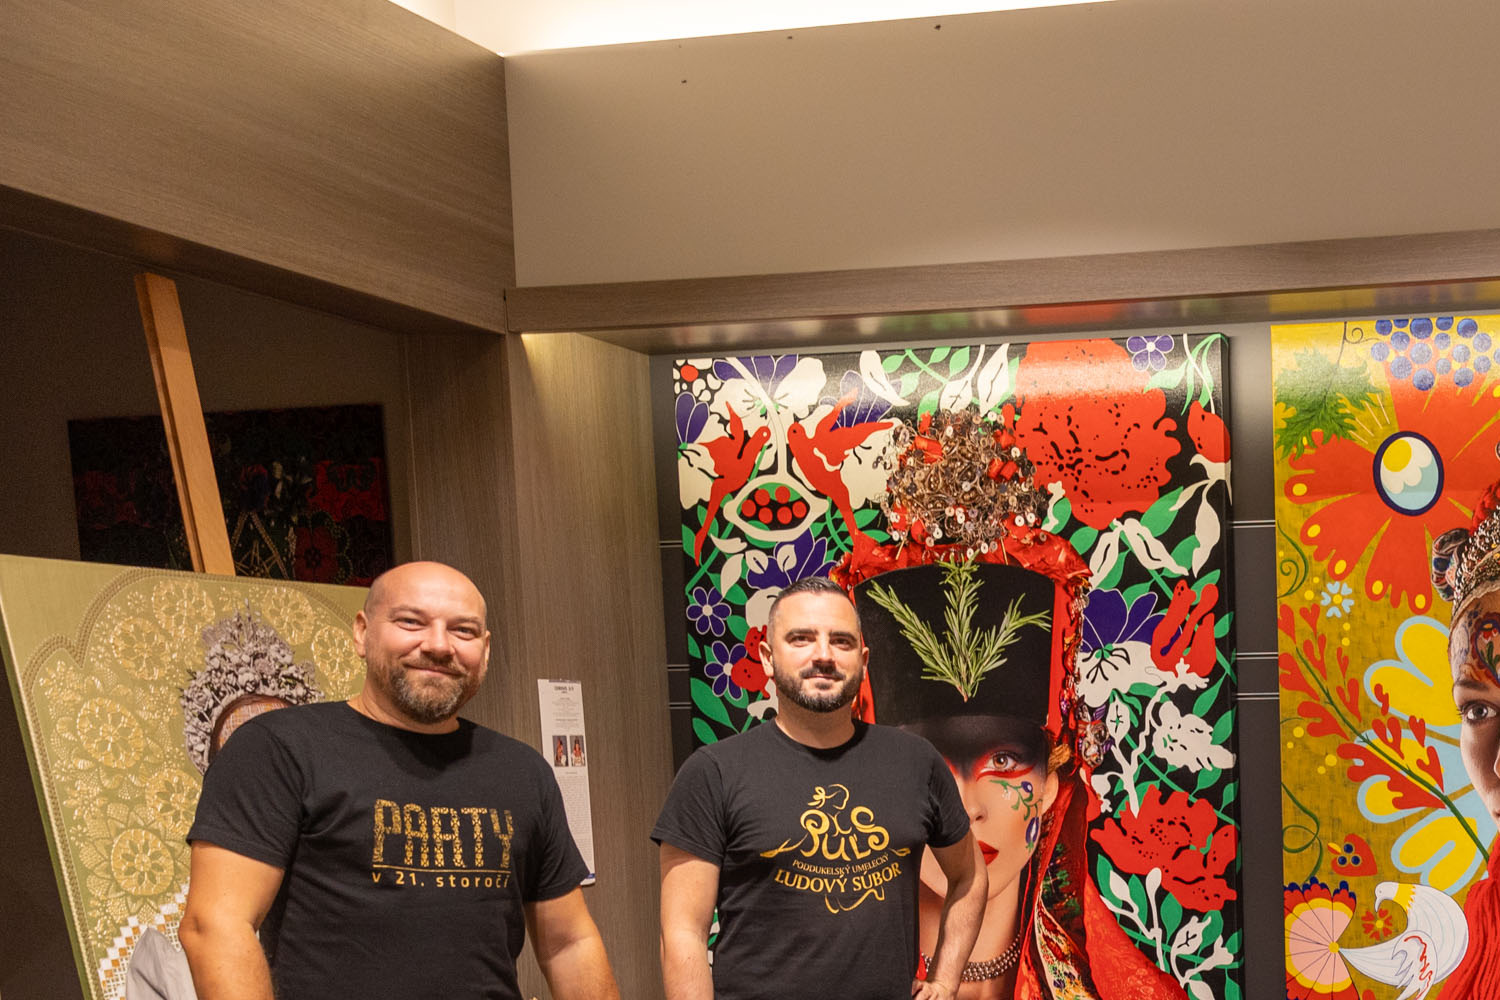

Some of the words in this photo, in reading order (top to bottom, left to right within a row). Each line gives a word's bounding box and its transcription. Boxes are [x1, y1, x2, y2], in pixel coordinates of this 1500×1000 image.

[372, 799, 514, 869] PARTY
[371, 871, 383, 884] v
[394, 870, 426, 888] 21.
[435, 873, 511, 889] storočí
[851, 861, 903, 892] SÚBOR
